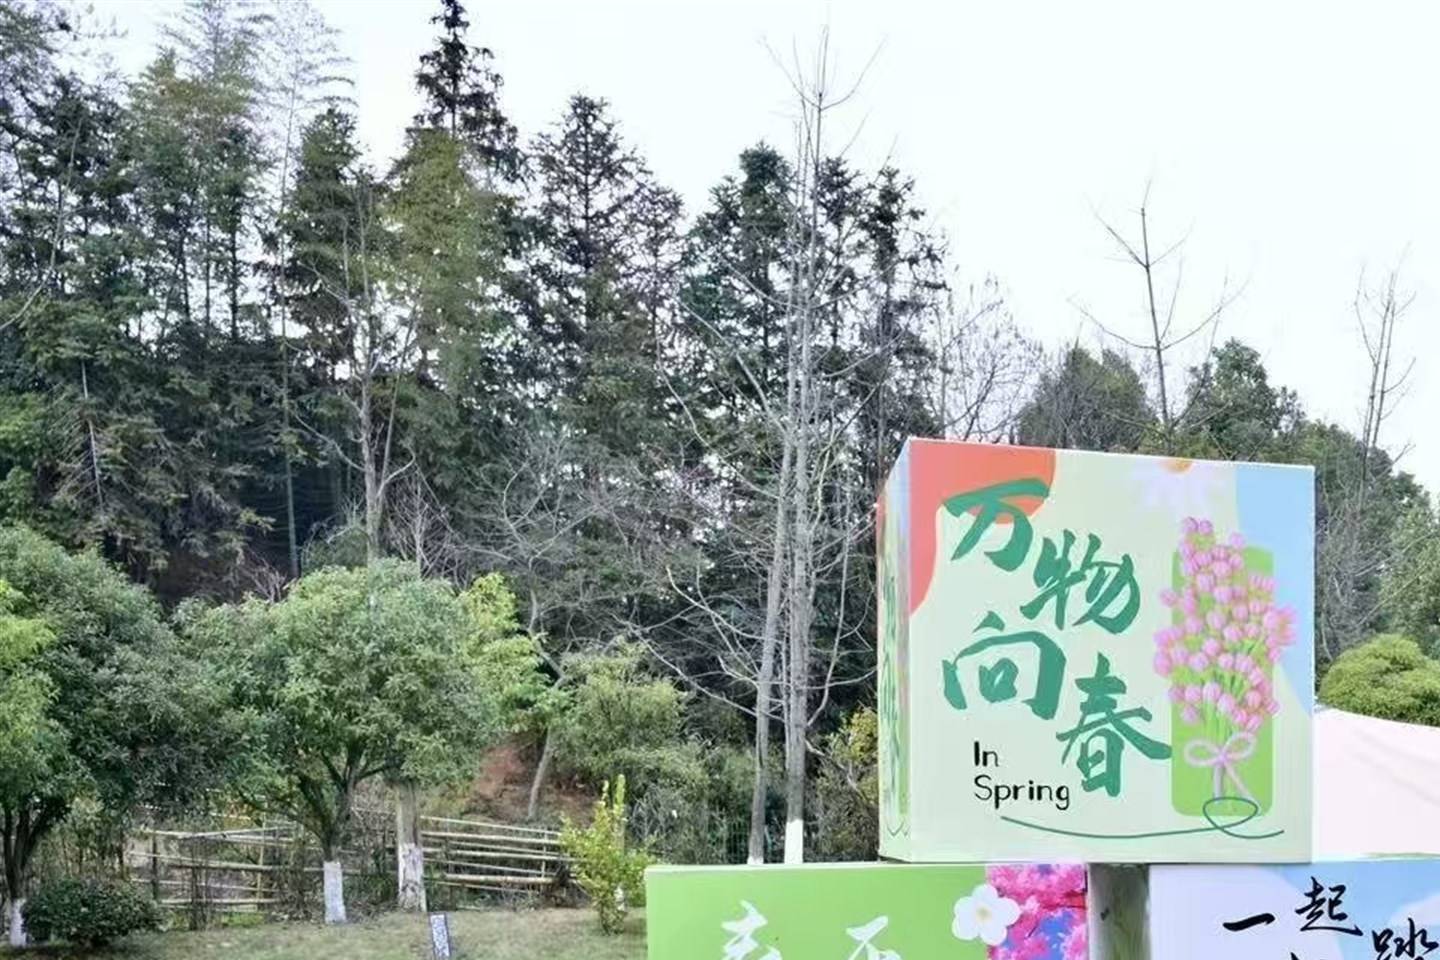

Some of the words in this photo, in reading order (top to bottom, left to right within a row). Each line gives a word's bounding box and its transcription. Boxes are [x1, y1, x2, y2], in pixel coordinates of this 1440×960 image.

[942, 477, 1141, 634] 万物
[942, 611, 1172, 797] 向春
[973, 740, 1000, 768] In
[973, 774, 1070, 809] Spring
[1222, 876, 1363, 936] 一起
